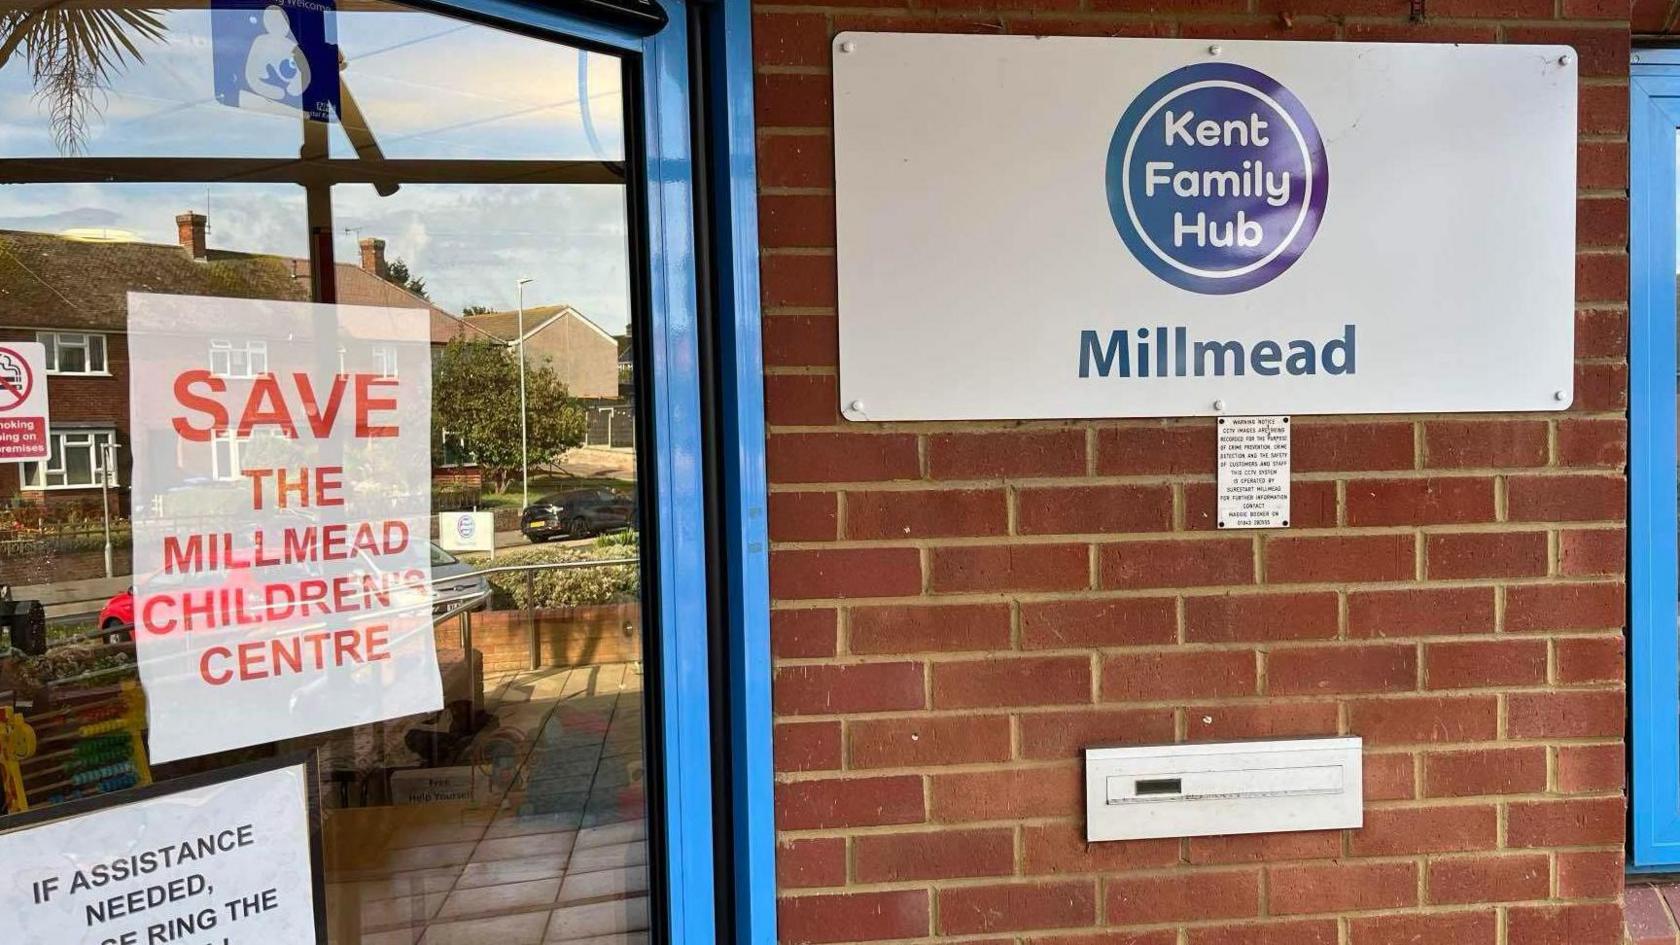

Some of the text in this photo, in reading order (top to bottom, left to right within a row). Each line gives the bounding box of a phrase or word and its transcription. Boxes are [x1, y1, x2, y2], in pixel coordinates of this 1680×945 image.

[1164, 110, 1270, 147] Kent
[1145, 161, 1290, 207] Family
[1173, 210, 1263, 247] Hub
[1078, 324, 1356, 378] Millmead
[172, 370, 400, 443] SAVE
[0, 444, 45, 453] remises
[22, 433, 37, 441] on
[243, 466, 344, 510] THE
[164, 520, 409, 574] MILLMEAD
[143, 568, 431, 636] CHILDREN'S
[200, 625, 391, 685] CENTRE
[33, 824, 255, 904] IF ASSISTANCE
[85, 873, 214, 926] NEEDED,
[148, 888, 279, 945] RING THE
